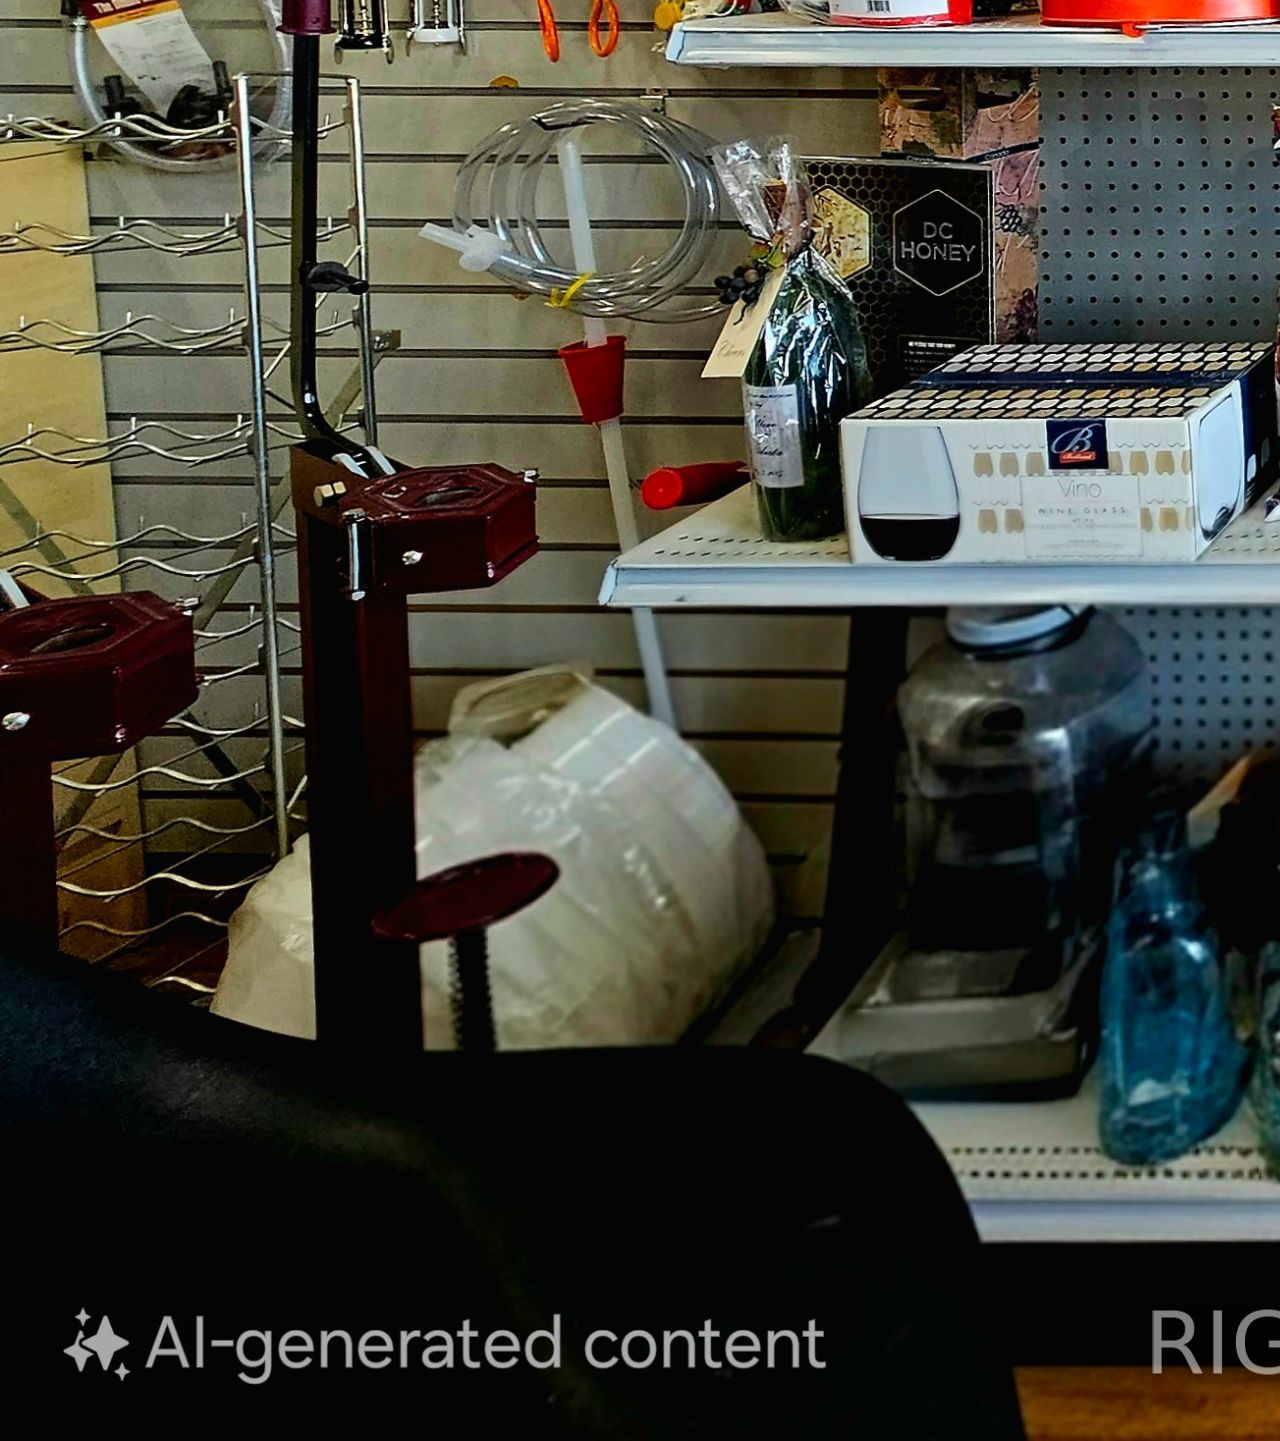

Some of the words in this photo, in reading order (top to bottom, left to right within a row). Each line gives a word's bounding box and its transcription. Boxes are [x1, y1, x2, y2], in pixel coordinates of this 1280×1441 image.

[923, 222, 953, 239] DC
[901, 241, 976, 262] HONEY
[1057, 479, 1102, 498] Vino
